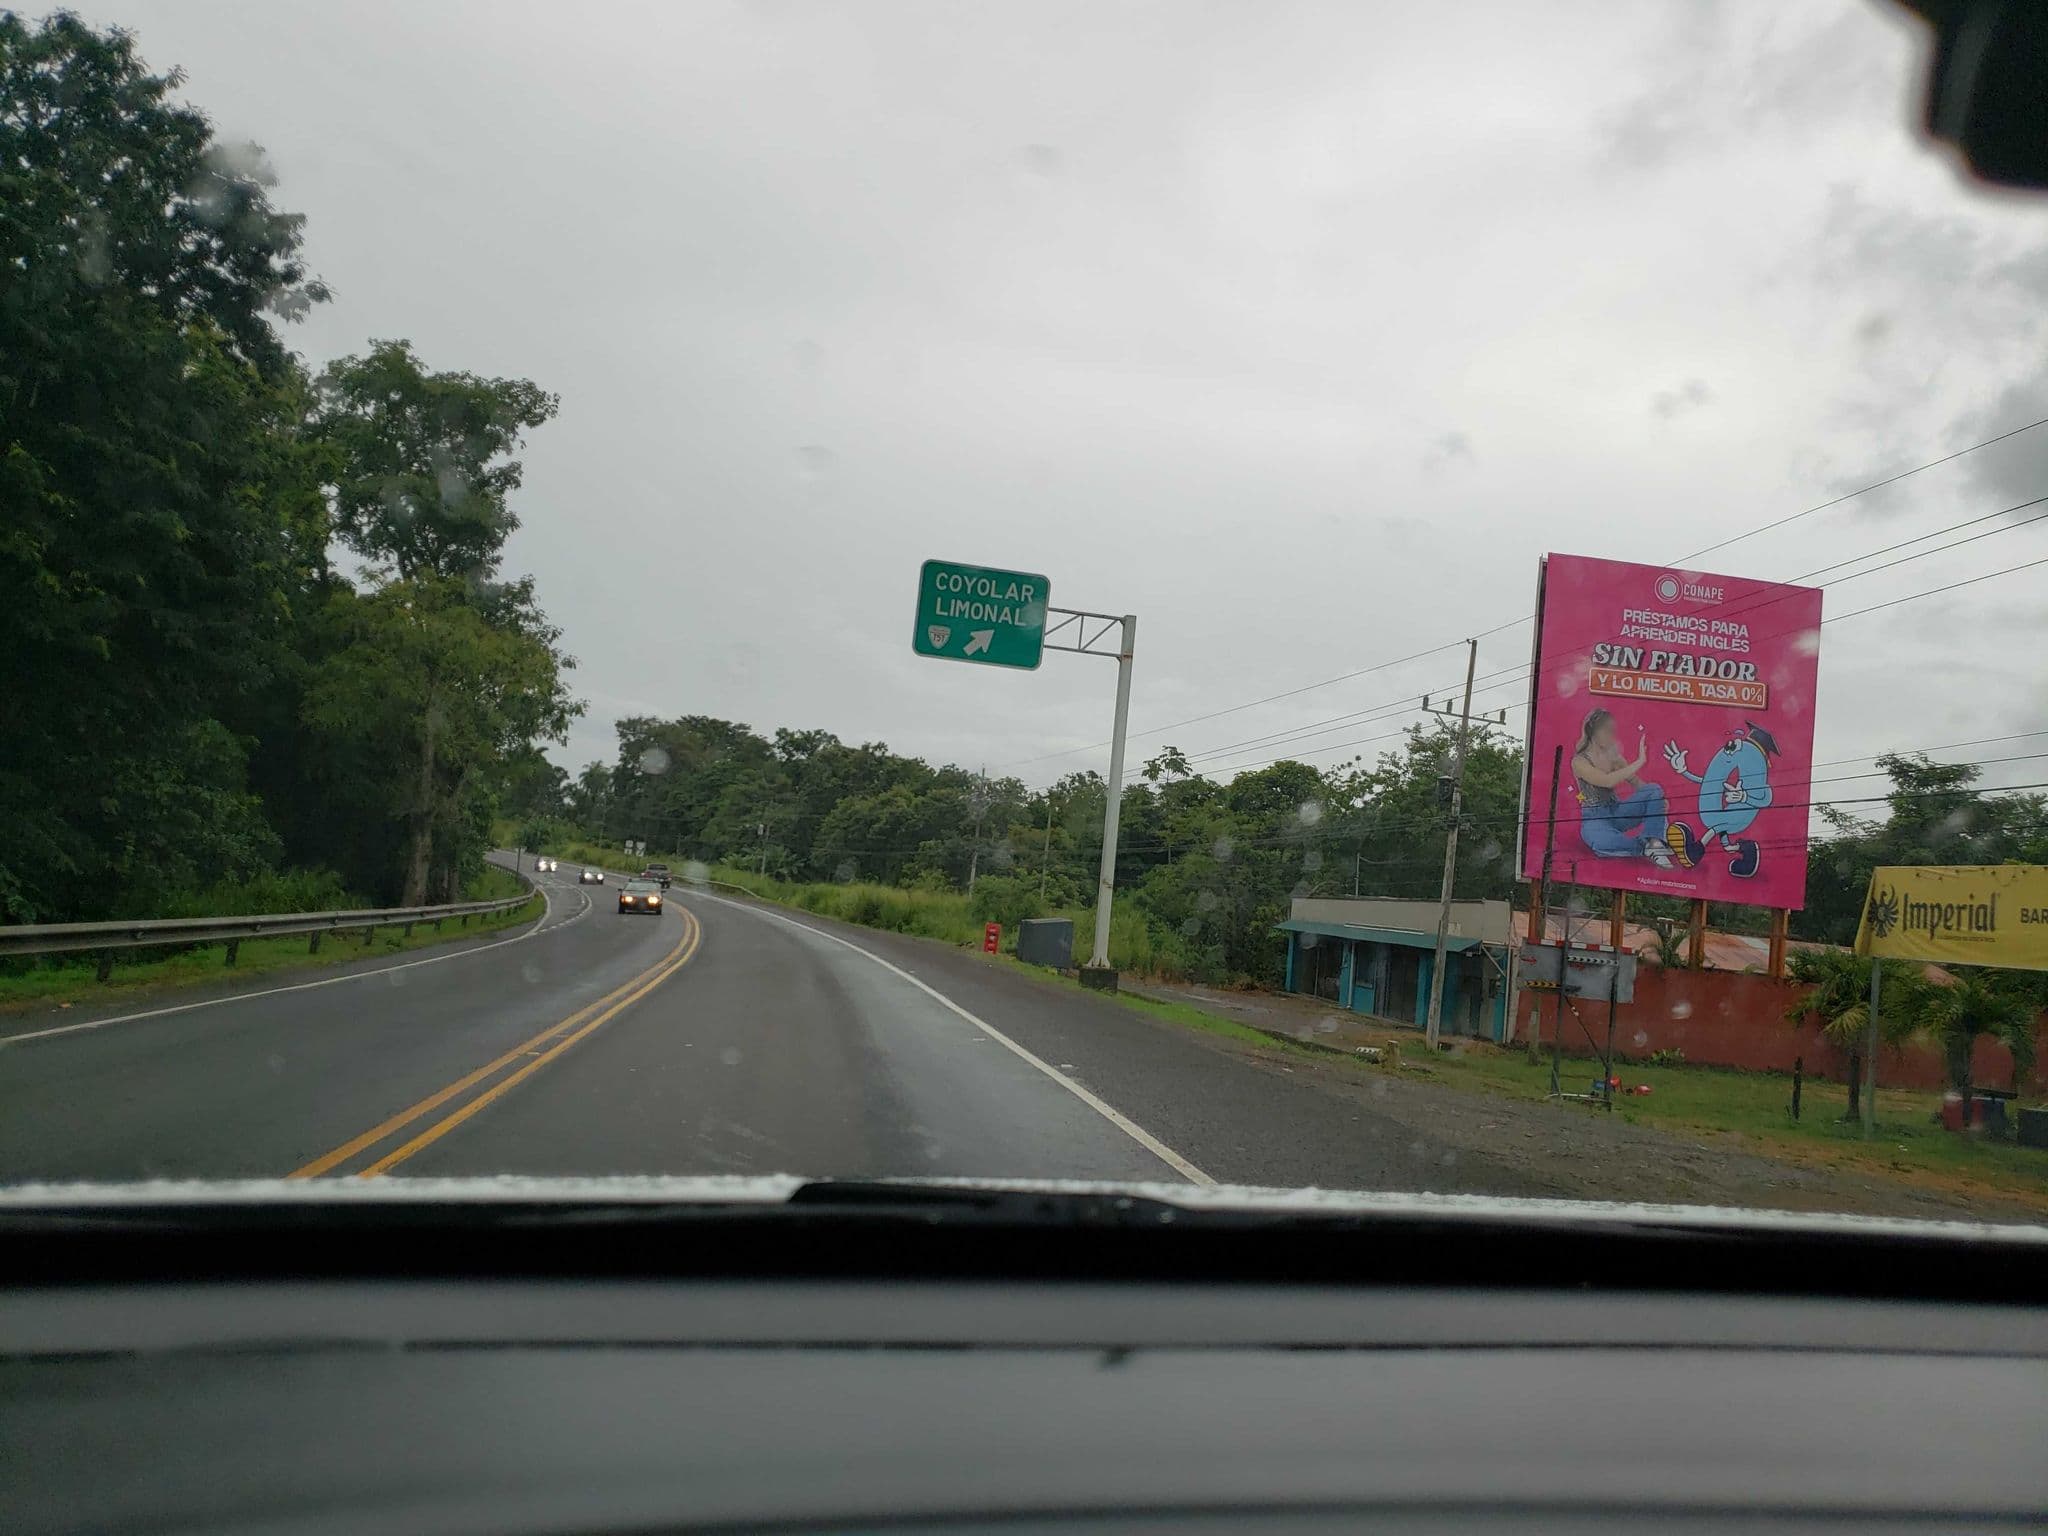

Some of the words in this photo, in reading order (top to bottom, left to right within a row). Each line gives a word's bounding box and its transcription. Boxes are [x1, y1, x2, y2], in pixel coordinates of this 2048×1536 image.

[936, 572, 1034, 602] COYOLAR
[1684, 584, 1724, 599] CONAPE
[936, 597, 1027, 627] LIMONAL
[1623, 608, 1708, 630] PRÉSTAMOS
[1712, 621, 1749, 638] PARA
[1620, 624, 1696, 645] APRENDER
[1700, 635, 1750, 652] INGLÉS
[1592, 642, 1644, 669] SIN
[1648, 651, 1756, 681] FIADOR
[1598, 674, 1609, 687] Y
[1612, 675, 1633, 689] LO
[1637, 678, 1694, 698] MEJOR,
[1699, 683, 1737, 700] TASA
[1741, 687, 1762, 702] 0%
[1903, 892, 1997, 940] Imperial
